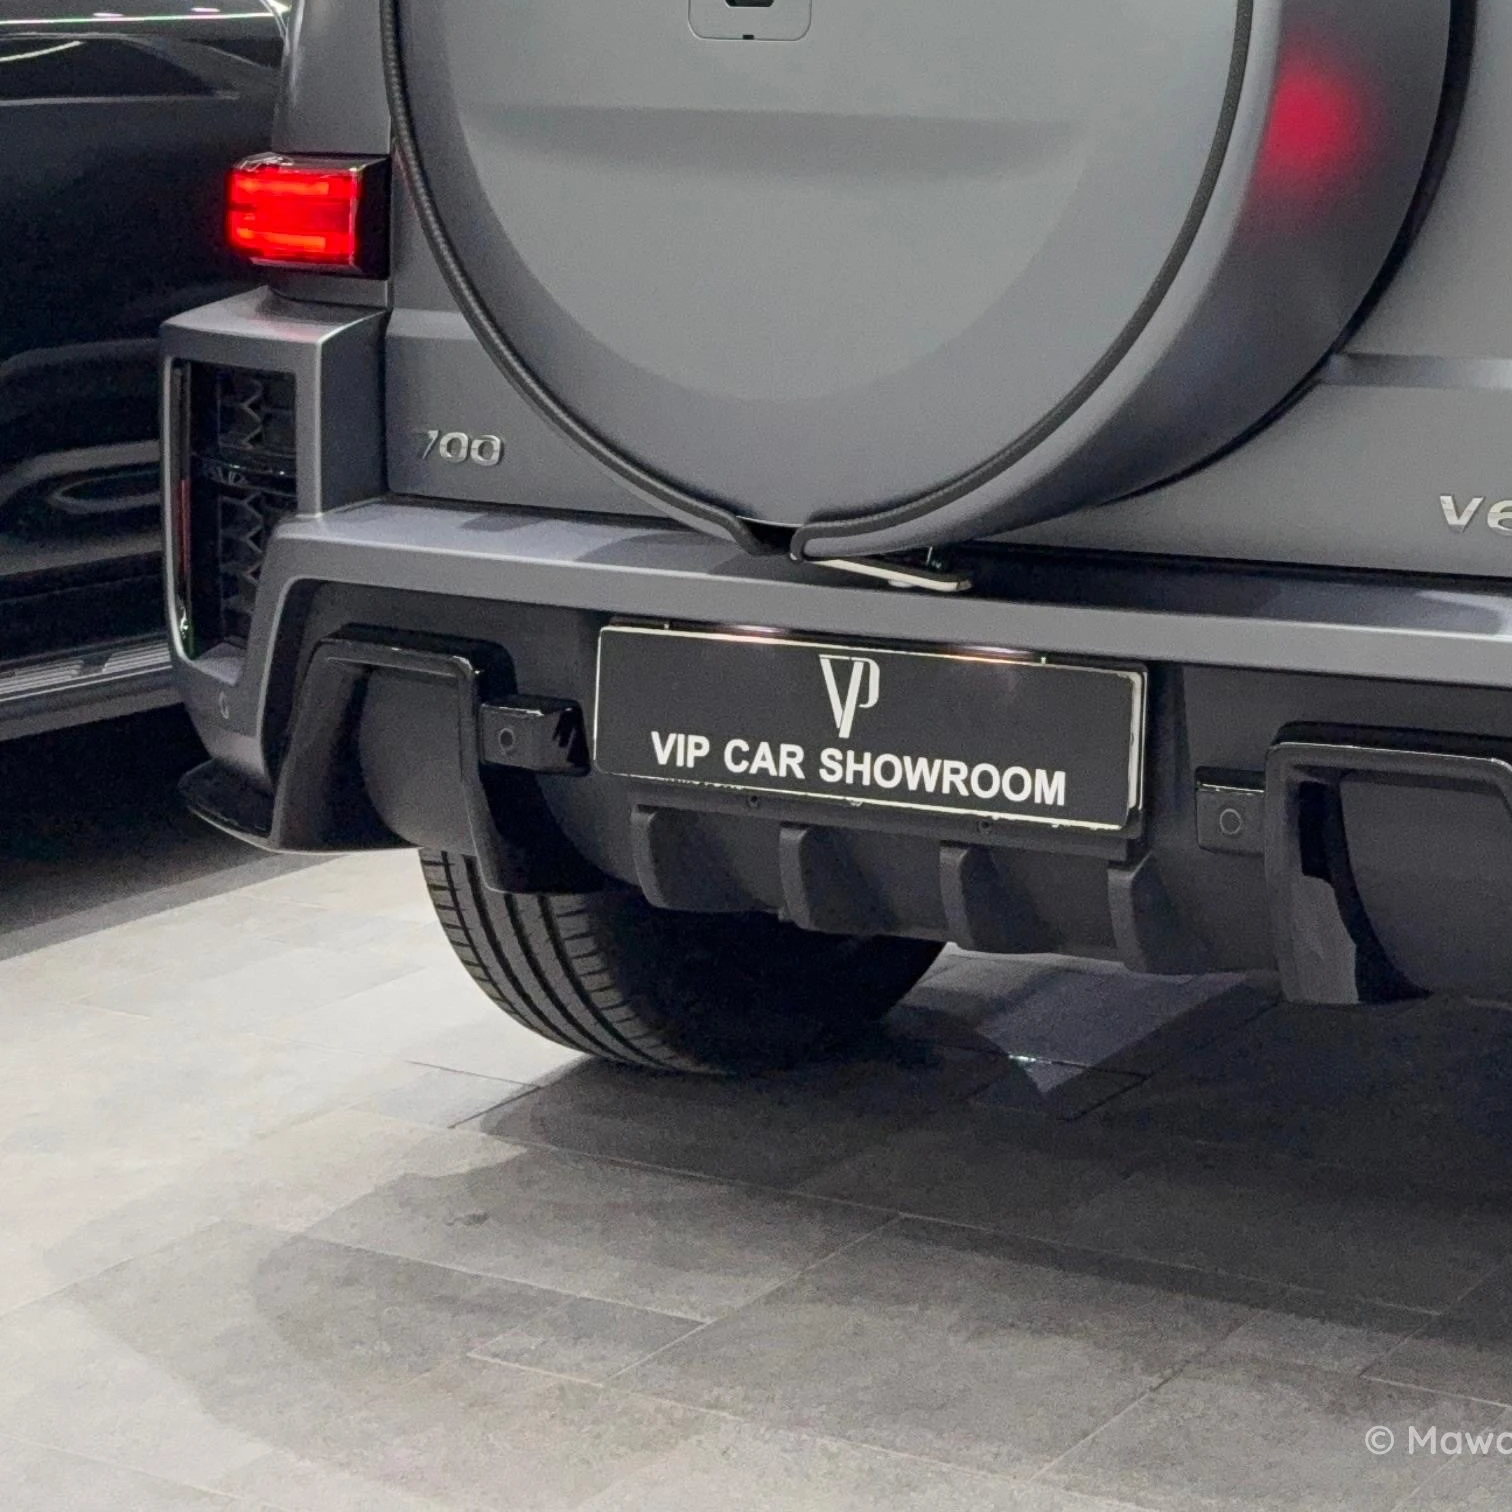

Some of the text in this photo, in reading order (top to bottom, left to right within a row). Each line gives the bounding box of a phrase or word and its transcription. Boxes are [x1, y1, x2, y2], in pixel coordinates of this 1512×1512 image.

[420, 429, 503, 467] 700
[651, 731, 1067, 807] VIP CAR SHOWROOM
